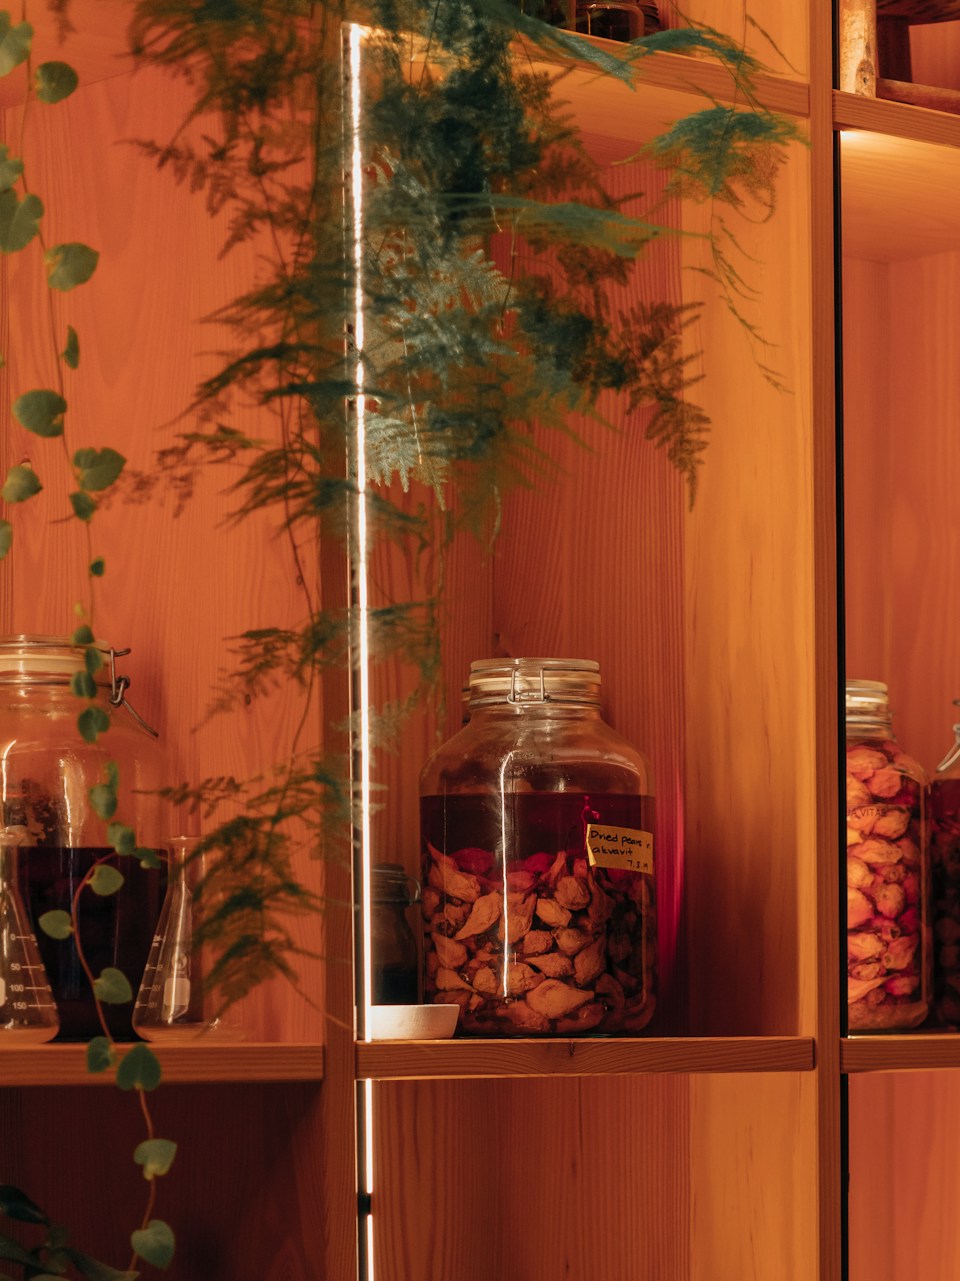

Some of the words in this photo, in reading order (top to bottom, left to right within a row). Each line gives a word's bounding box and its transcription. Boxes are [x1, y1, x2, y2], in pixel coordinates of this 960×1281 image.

[590, 830, 618, 842] Dried
[621, 836, 642, 847] pears
[592, 846, 633, 856] akvavit
[10, 963, 21, 971] 50
[9, 984, 24, 992] 100
[12, 1002, 27, 1010] 150
